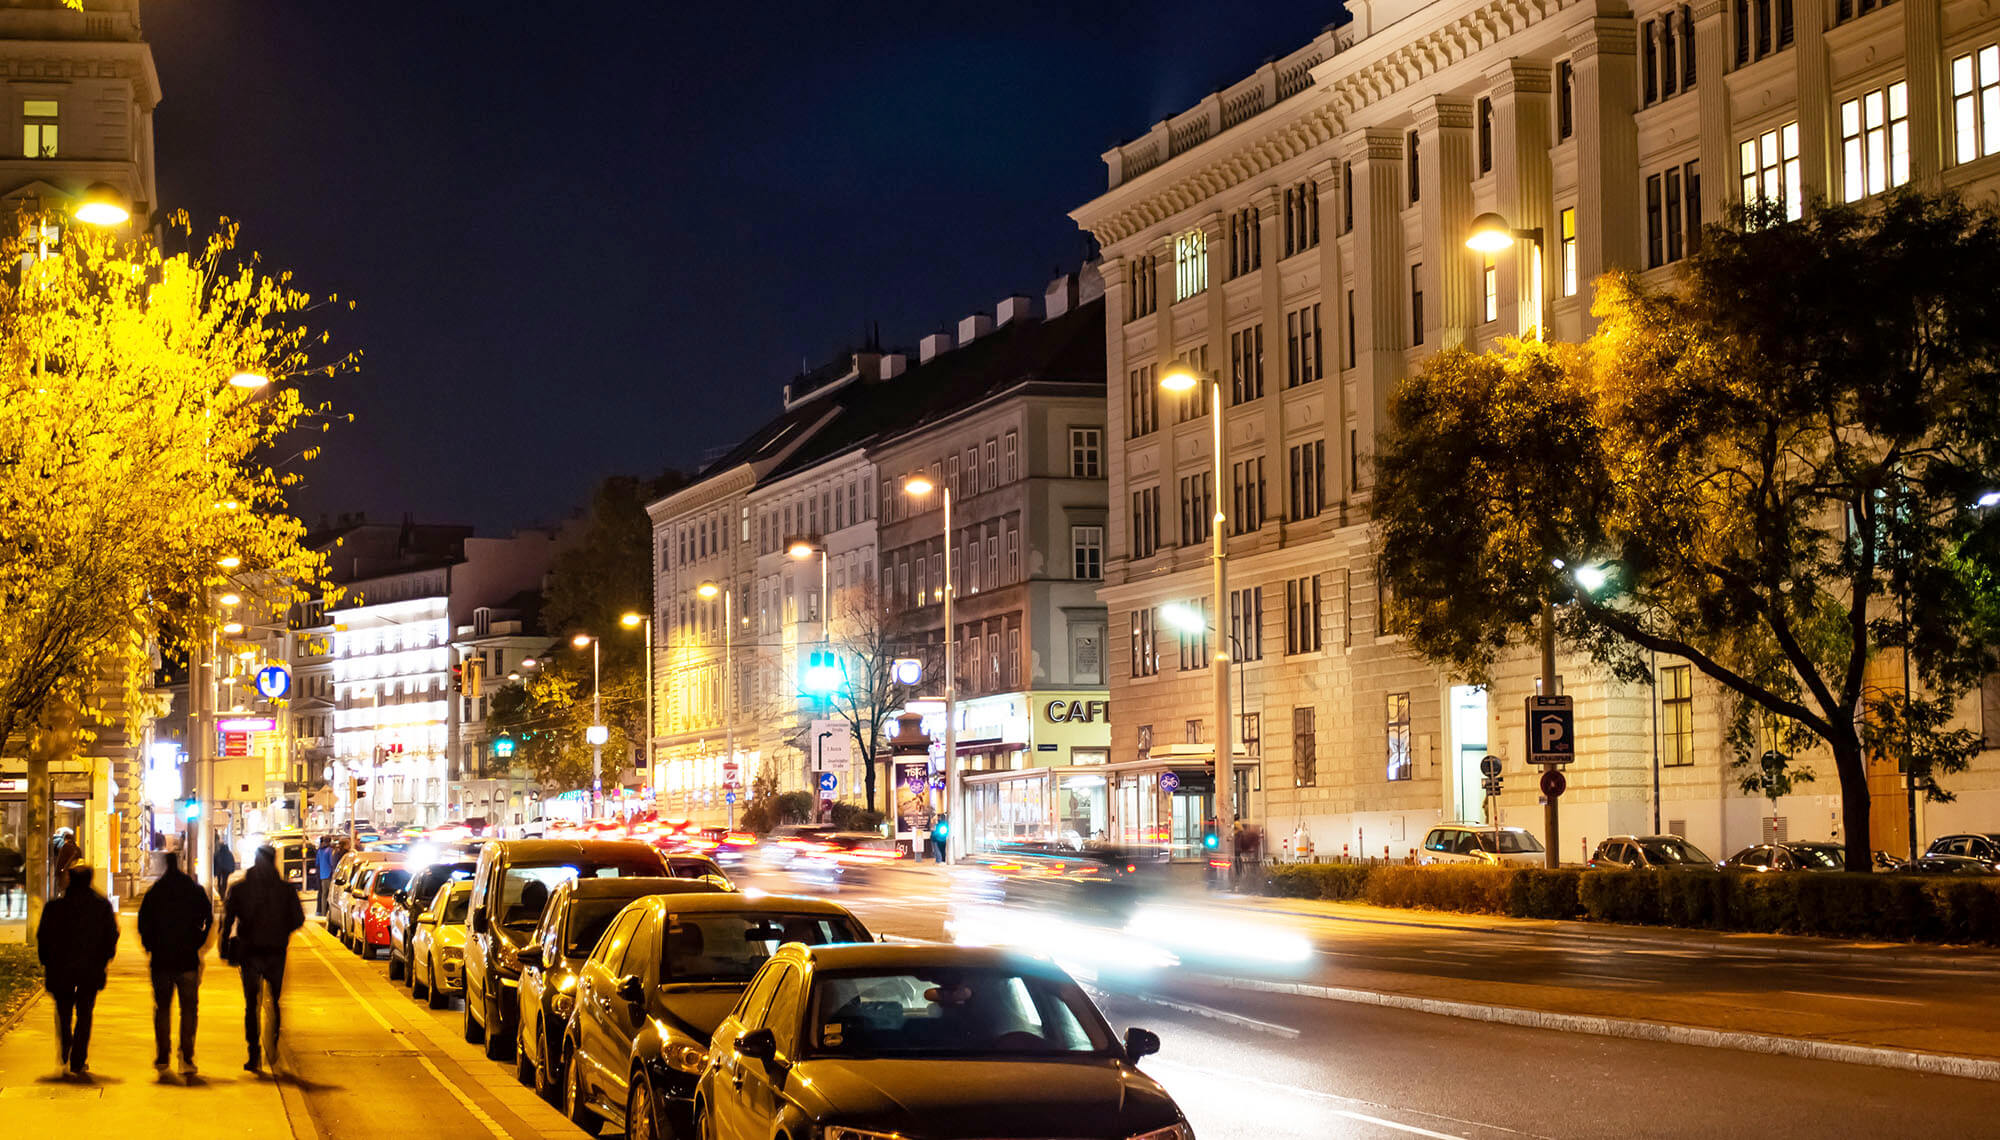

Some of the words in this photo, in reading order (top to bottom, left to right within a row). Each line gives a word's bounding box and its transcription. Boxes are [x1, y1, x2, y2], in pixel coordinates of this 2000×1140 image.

[260, 671, 286, 698] U
[1046, 700, 1111, 724] CAF
[1541, 722, 1564, 752] P
